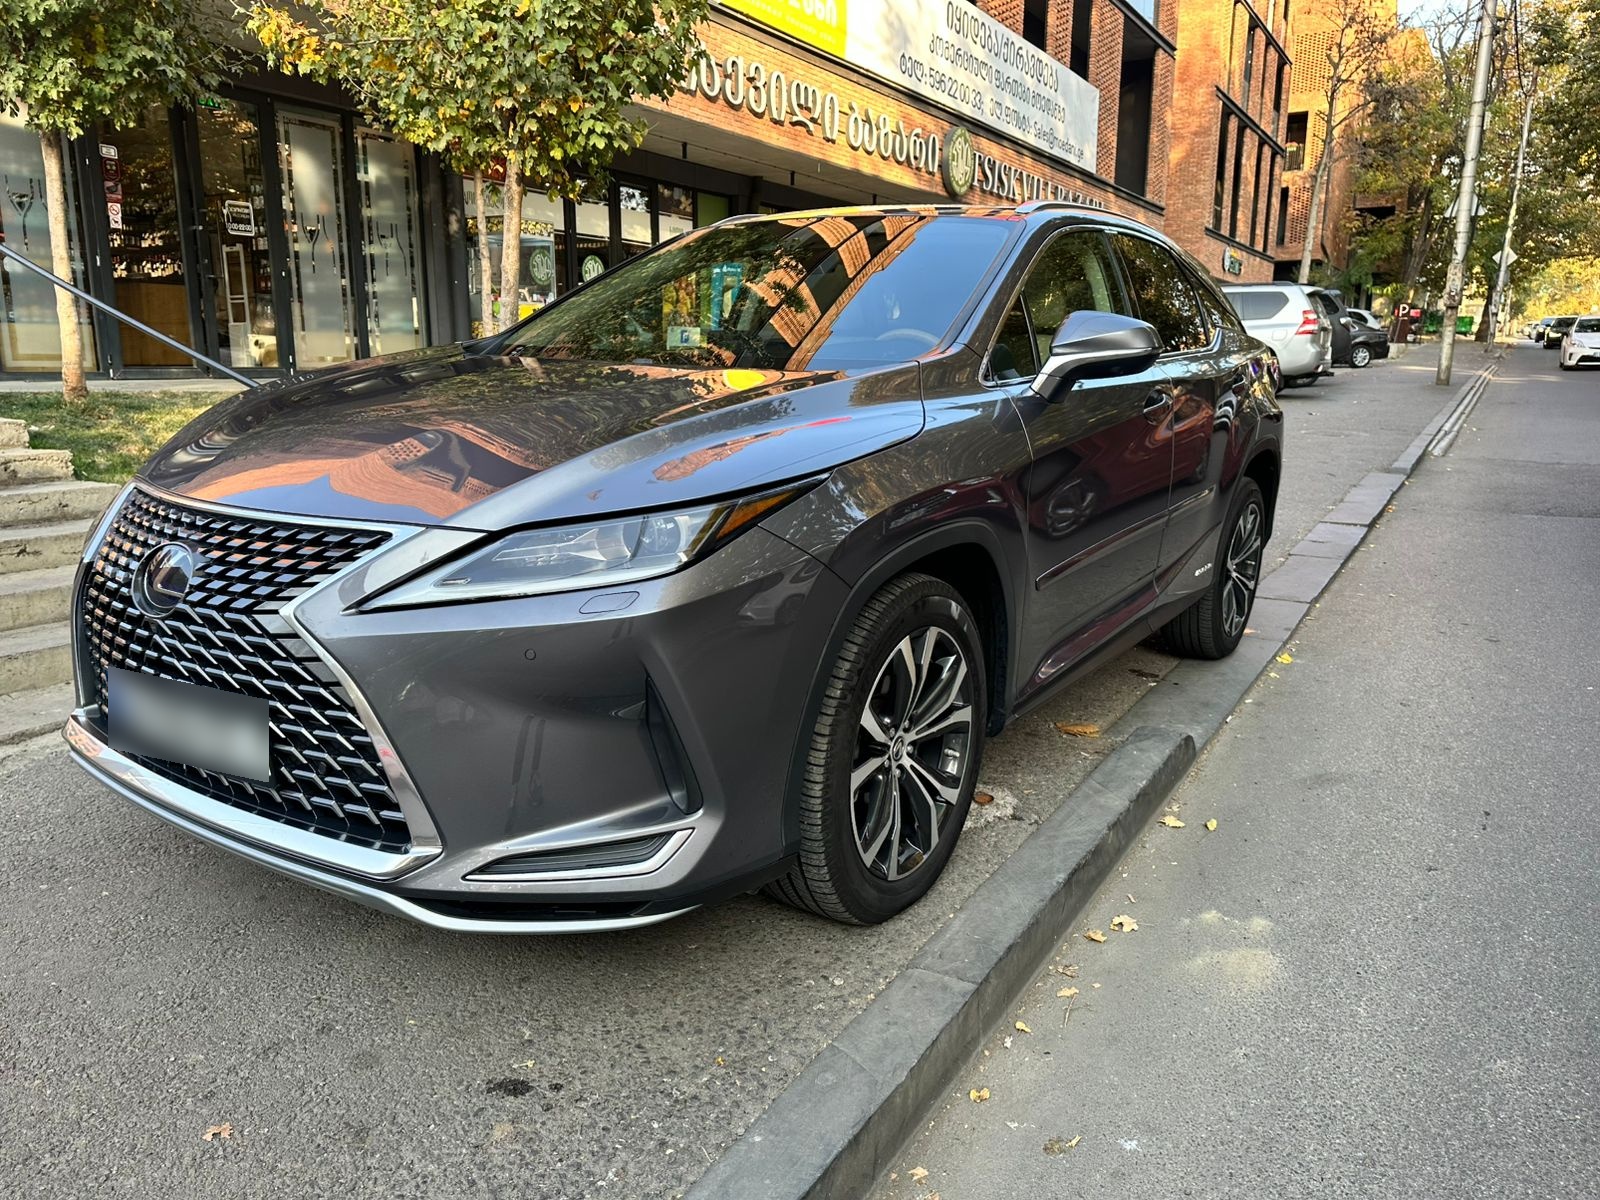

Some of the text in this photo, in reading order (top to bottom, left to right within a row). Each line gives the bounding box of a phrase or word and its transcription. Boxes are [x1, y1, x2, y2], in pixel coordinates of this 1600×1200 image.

[946, 2, 1059, 93] იყიდება/ქირავდება
[929, 67, 947, 94] 596
[947, 77, 959, 100] 22
[959, 84, 970, 105] 00
[849, 102, 939, 174] ბაზარი
[1399, 303, 1409, 317] P
